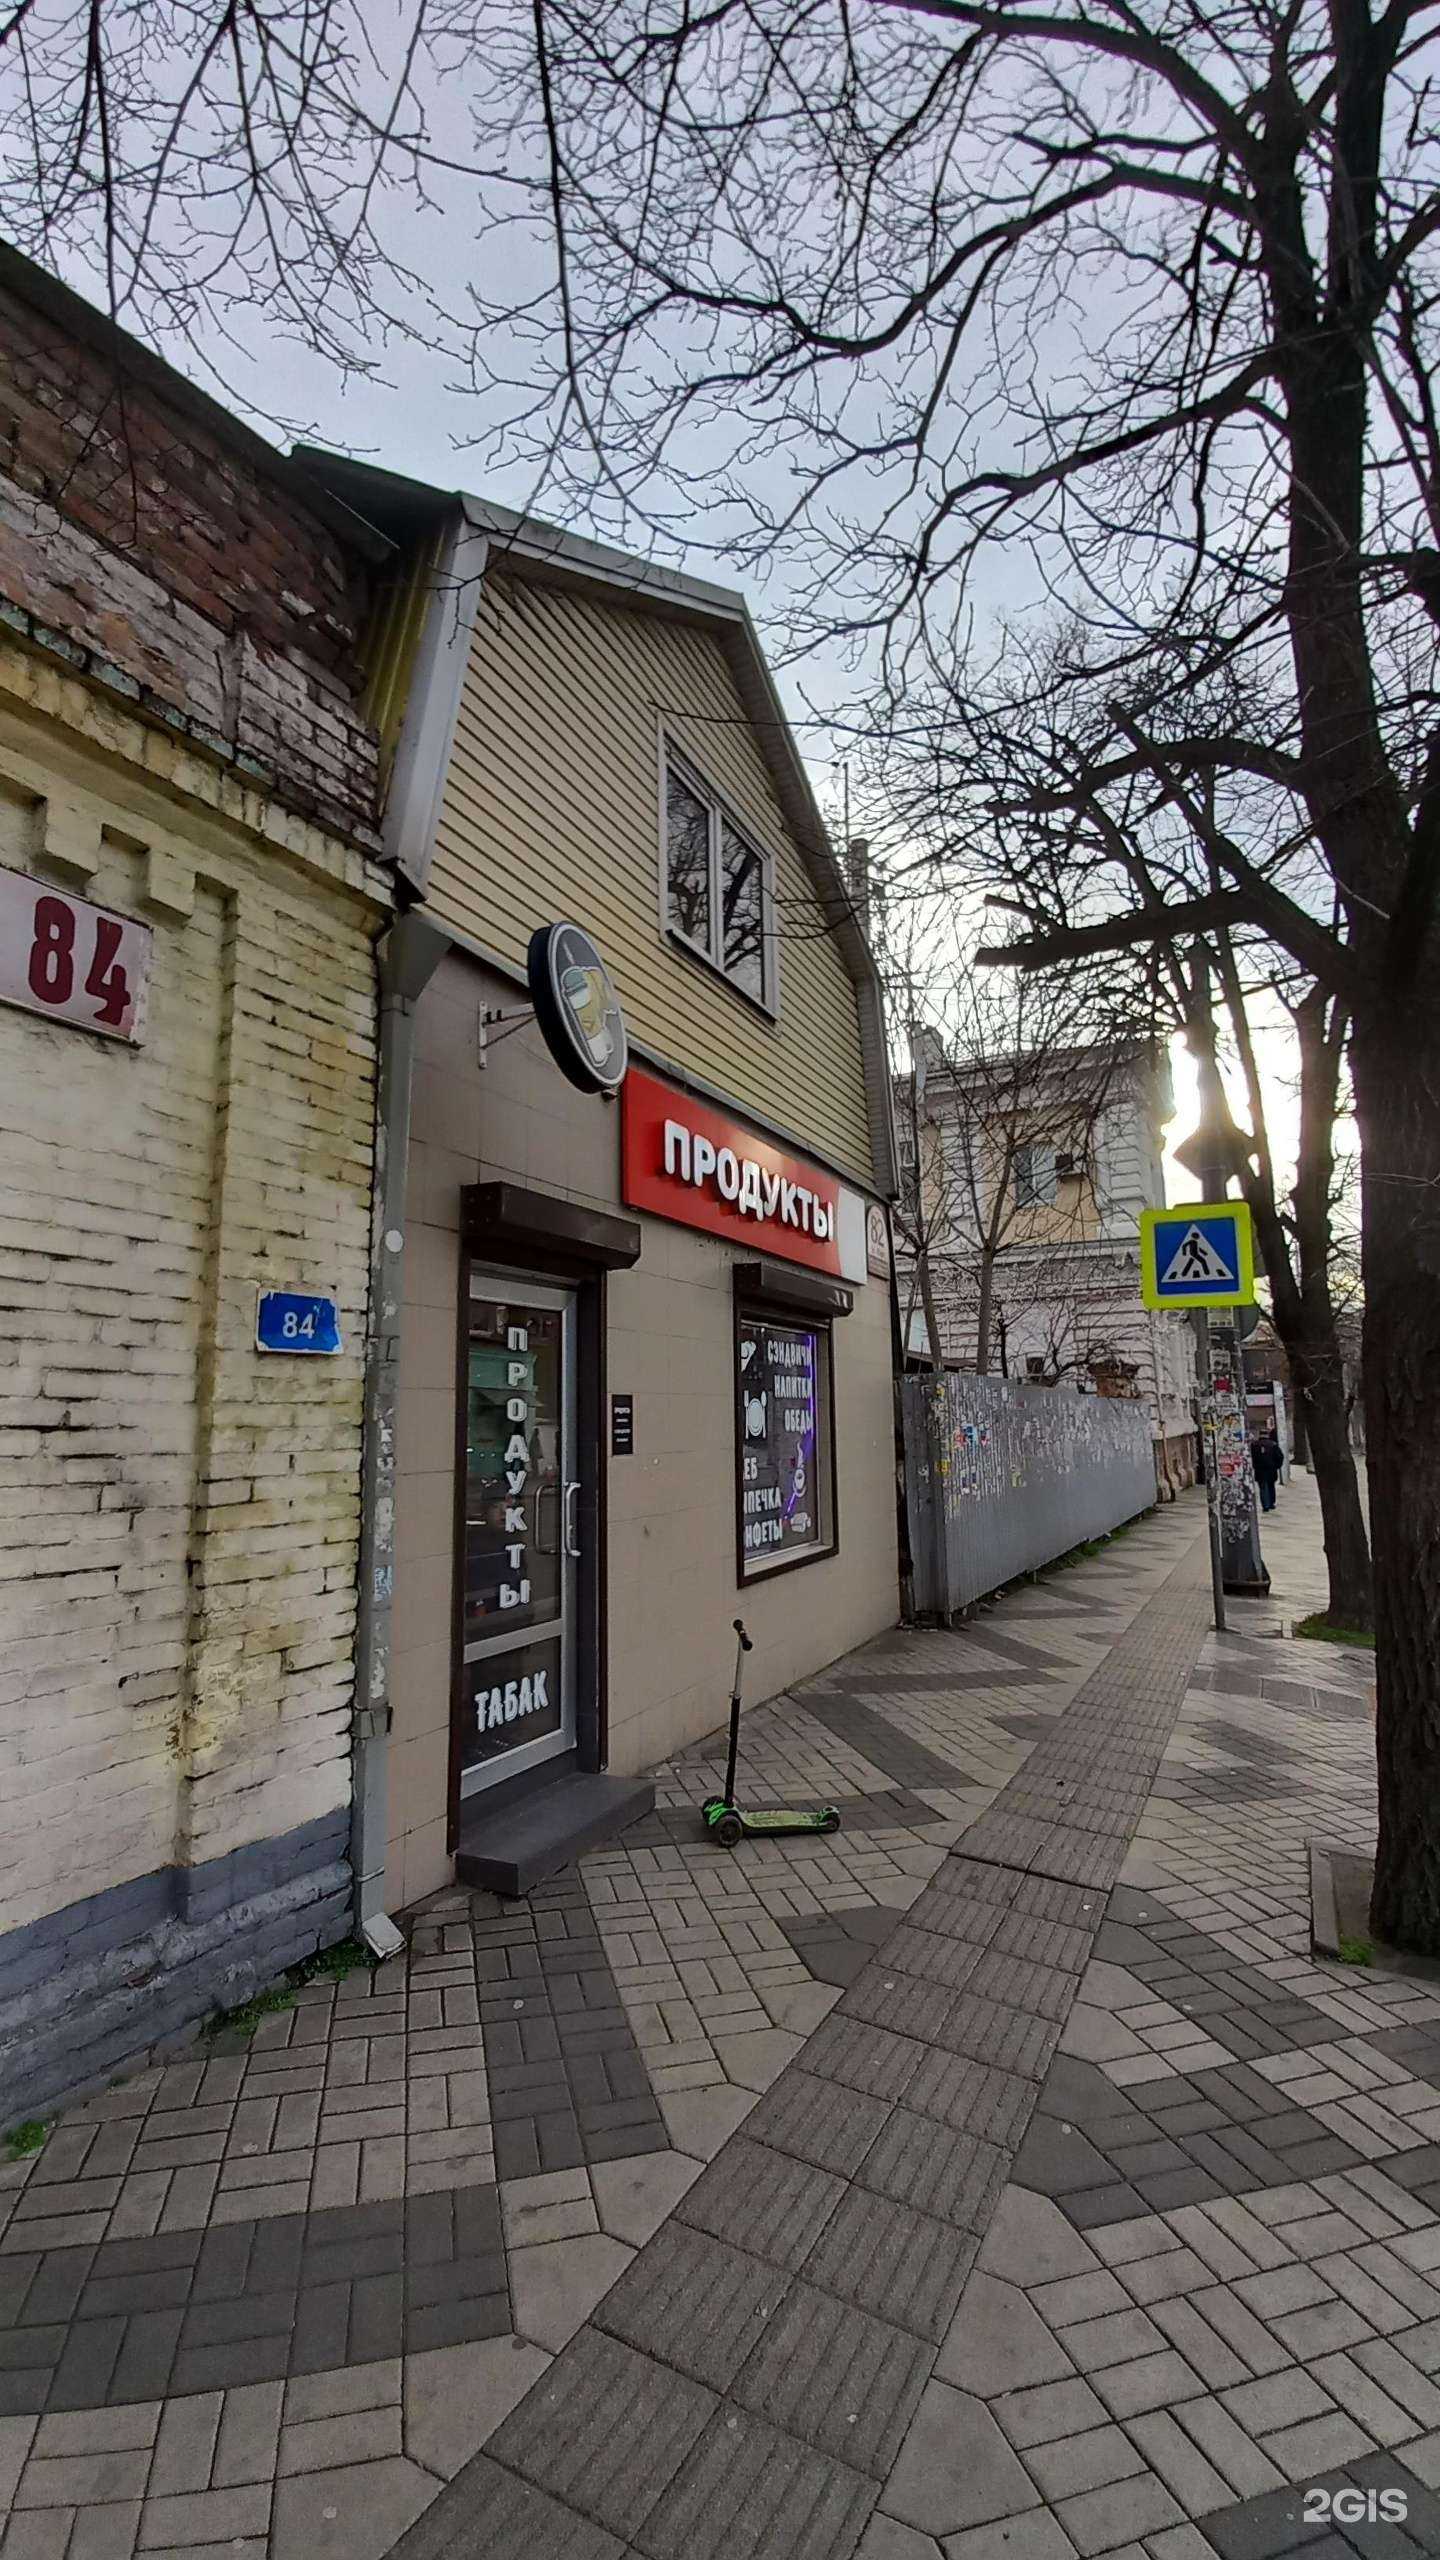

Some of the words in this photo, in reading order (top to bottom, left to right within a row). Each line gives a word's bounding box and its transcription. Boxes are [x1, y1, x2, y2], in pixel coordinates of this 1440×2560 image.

[28, 896, 131, 1026] 84
[664, 1118, 834, 1242] ПРОДУКТЫ
[871, 1214, 884, 1247] 82
[282, 1311, 315, 1340] 84
[774, 1375, 812, 1399] НАПИТКИ
[499, 1326, 530, 1608] ПРОДУКТЫ
[743, 1457, 758, 1481] ЕБ
[743, 1487, 782, 1514] ПЕЧКА
[744, 1519, 783, 1547] НФЕТЫ
[474, 1670, 549, 1733] ТАБАК
